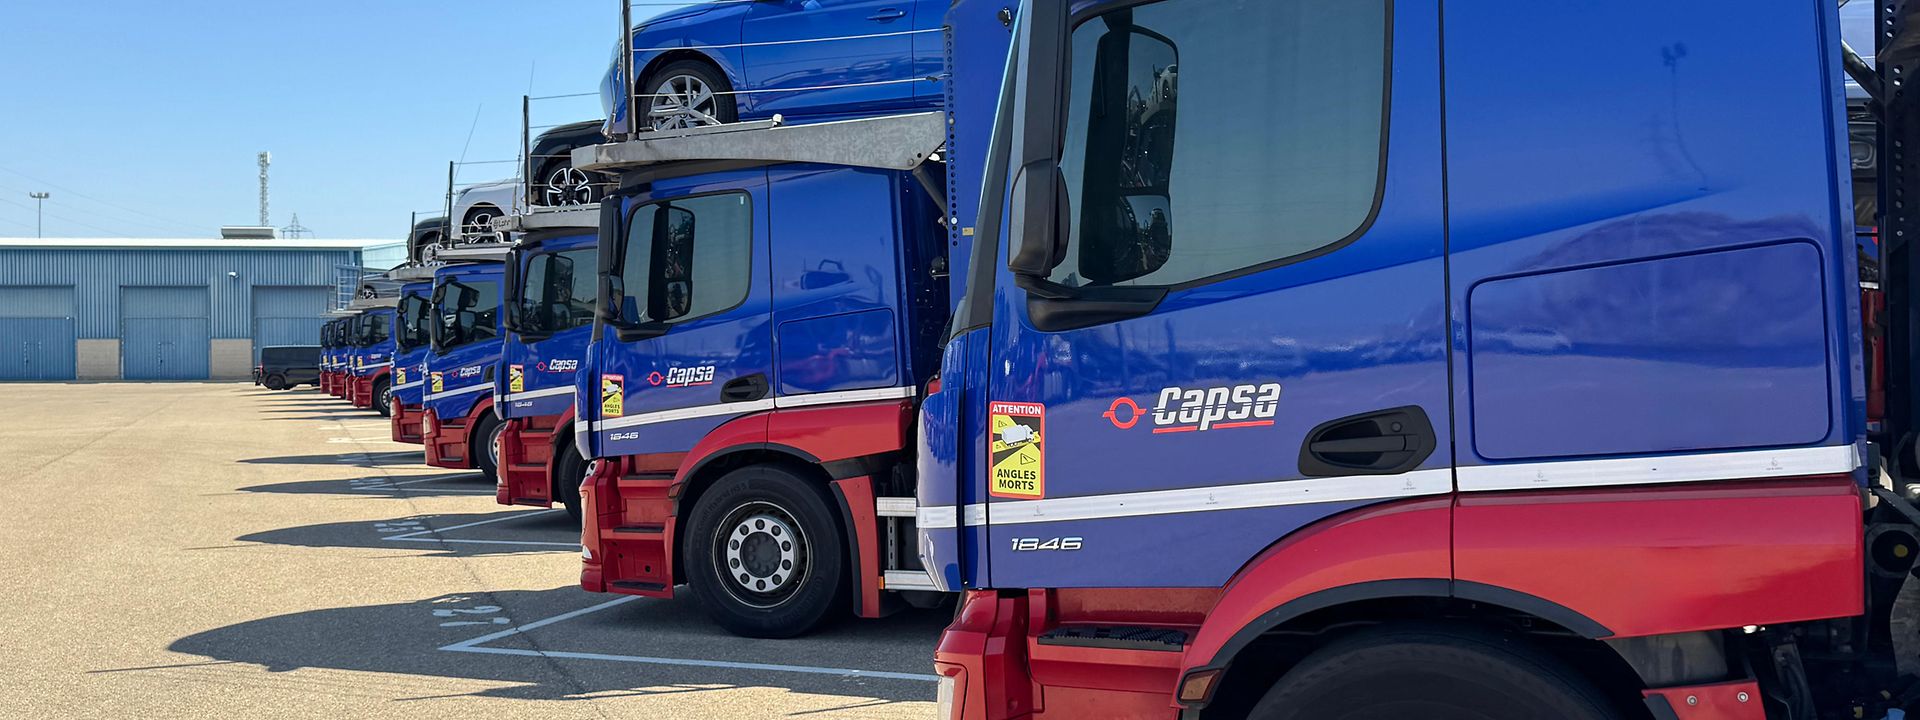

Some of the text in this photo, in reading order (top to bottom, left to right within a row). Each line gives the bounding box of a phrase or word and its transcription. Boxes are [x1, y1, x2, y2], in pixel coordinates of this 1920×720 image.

[549, 359, 578, 372] Capsa
[666, 366, 715, 386] Capsa
[992, 404, 1041, 414] ATTENTION
[1152, 383, 1282, 431] Capsa
[610, 432, 639, 441] 1846
[996, 468, 1036, 480] ANGLES
[998, 479, 1035, 490] MORTS
[1010, 536, 1083, 552] 1846
